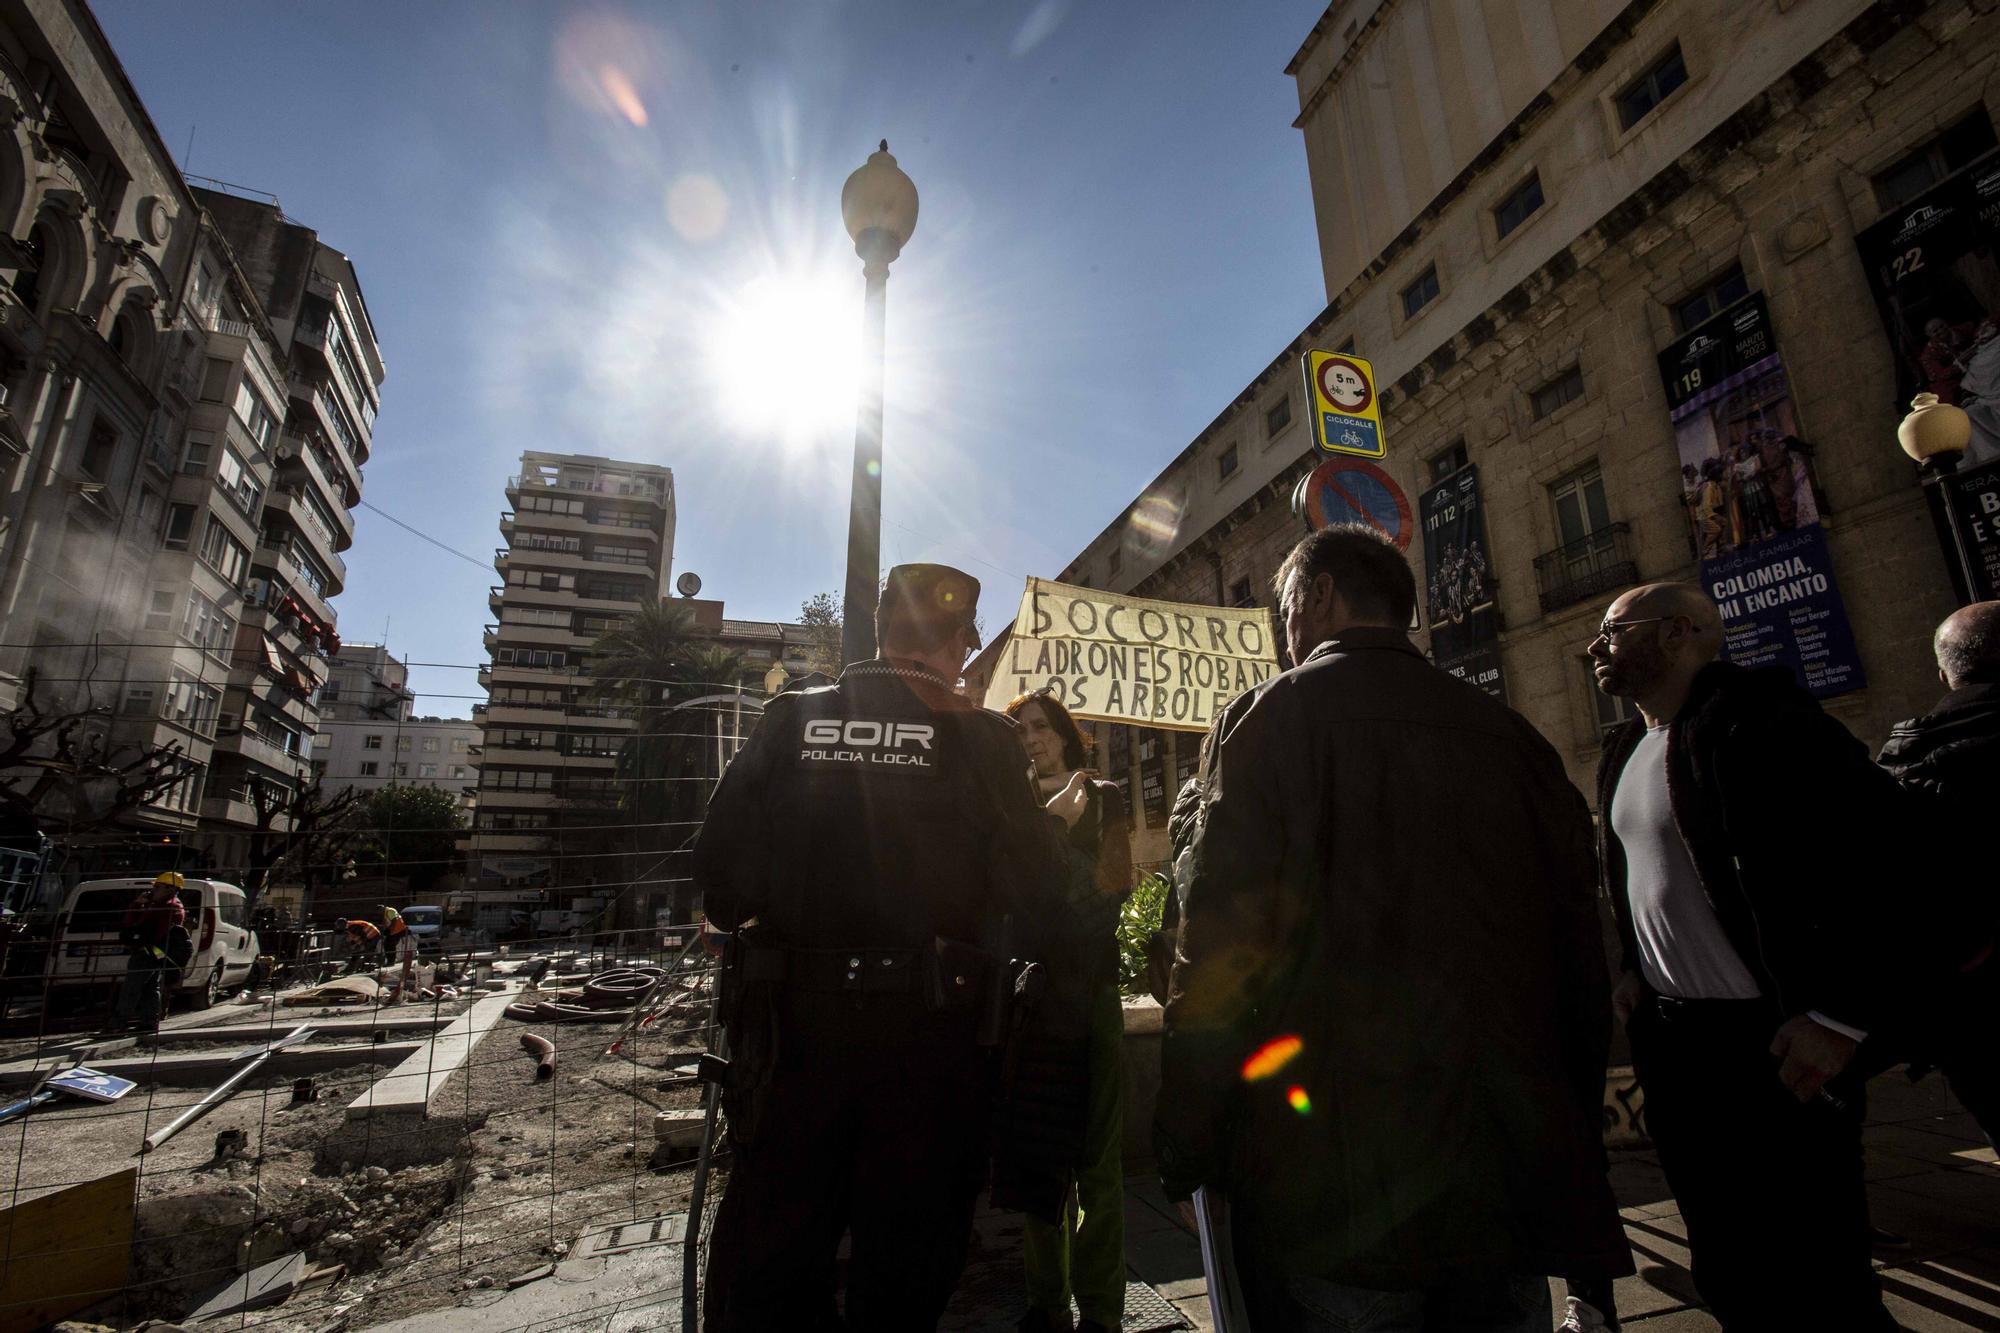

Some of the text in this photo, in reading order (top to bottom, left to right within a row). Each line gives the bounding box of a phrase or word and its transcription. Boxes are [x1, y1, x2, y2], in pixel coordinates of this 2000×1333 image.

[1892, 246, 1925, 281] 22
[1744, 341, 1767, 359] 2023
[1336, 373, 1356, 385] 5 m
[1682, 368, 1701, 393] 19
[1326, 415, 1373, 428] CICLOCALLE
[1980, 492, 2000, 514] B
[1430, 505, 1456, 531] 11 12
[1759, 533, 1813, 557] FAMILIAR
[1713, 556, 1812, 599] COLOMBIA,
[1718, 573, 1828, 621] MI ENCANTO
[1031, 580, 1263, 655] SOCORRO
[1012, 640, 1271, 691] LADRONES ROBAN
[1479, 668, 1499, 684] CLUB
[1105, 680, 1228, 722] ARBOLE
[803, 719, 935, 749] GOIR
[801, 750, 931, 766] POLICIA LOCAL
